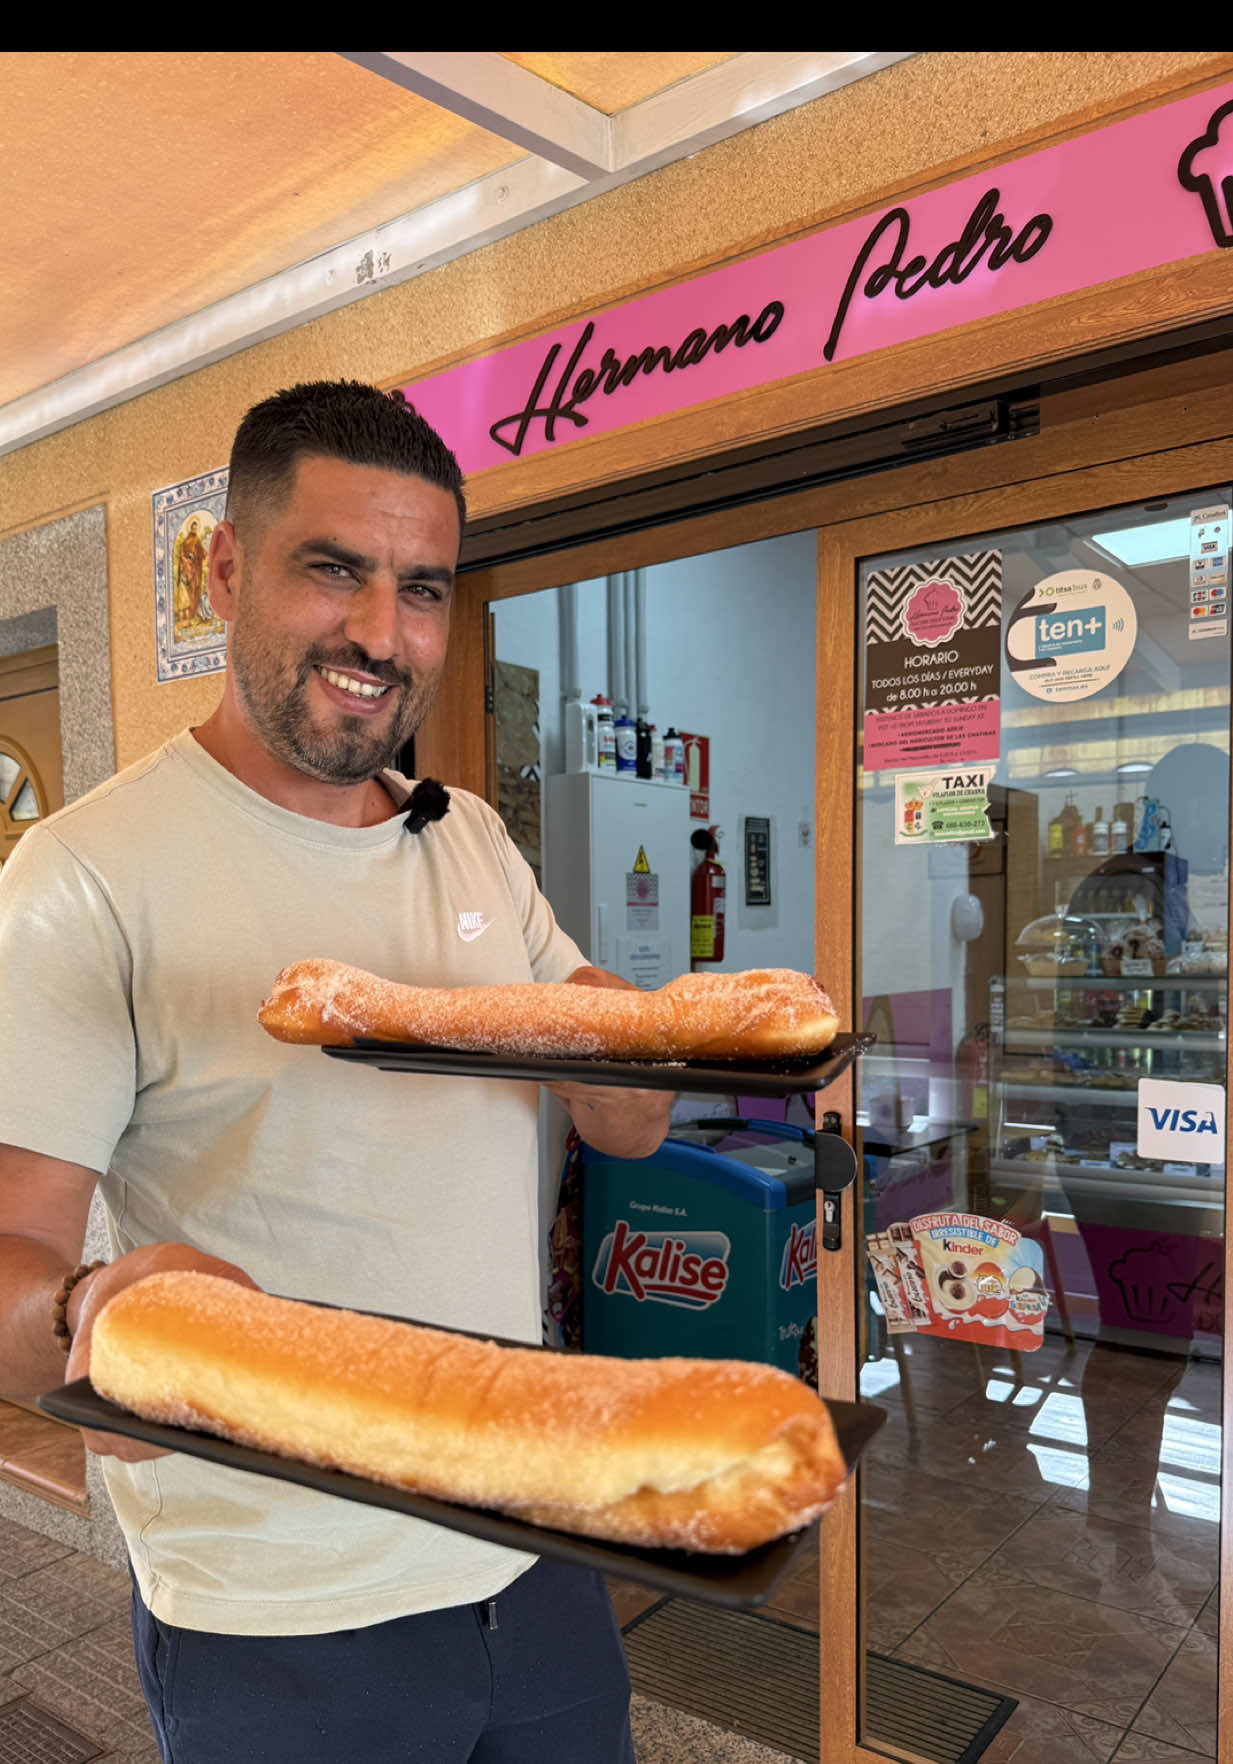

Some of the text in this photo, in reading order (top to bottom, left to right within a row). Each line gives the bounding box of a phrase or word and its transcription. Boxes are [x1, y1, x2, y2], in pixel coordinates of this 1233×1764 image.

[489, 188, 1054, 456] Hermano Pedro
[1039, 617, 1102, 641] ten+
[904, 650, 959, 669] HORARIO
[872, 664, 994, 689] TODOS LOS DÍAS / EVERYDAY
[886, 693, 898, 702] de
[900, 688, 921, 700] 8.00
[923, 687, 930, 697] h
[940, 682, 968, 695] 20.00
[970, 681, 977, 691] h
[942, 774, 984, 790] TAXI
[458, 912, 483, 930] NIKE
[1144, 1107, 1218, 1134] VISA
[912, 1214, 1018, 1245] DISFRUTA DEL SABOR
[985, 1234, 998, 1247] DE
[604, 1222, 727, 1300] Kalise
